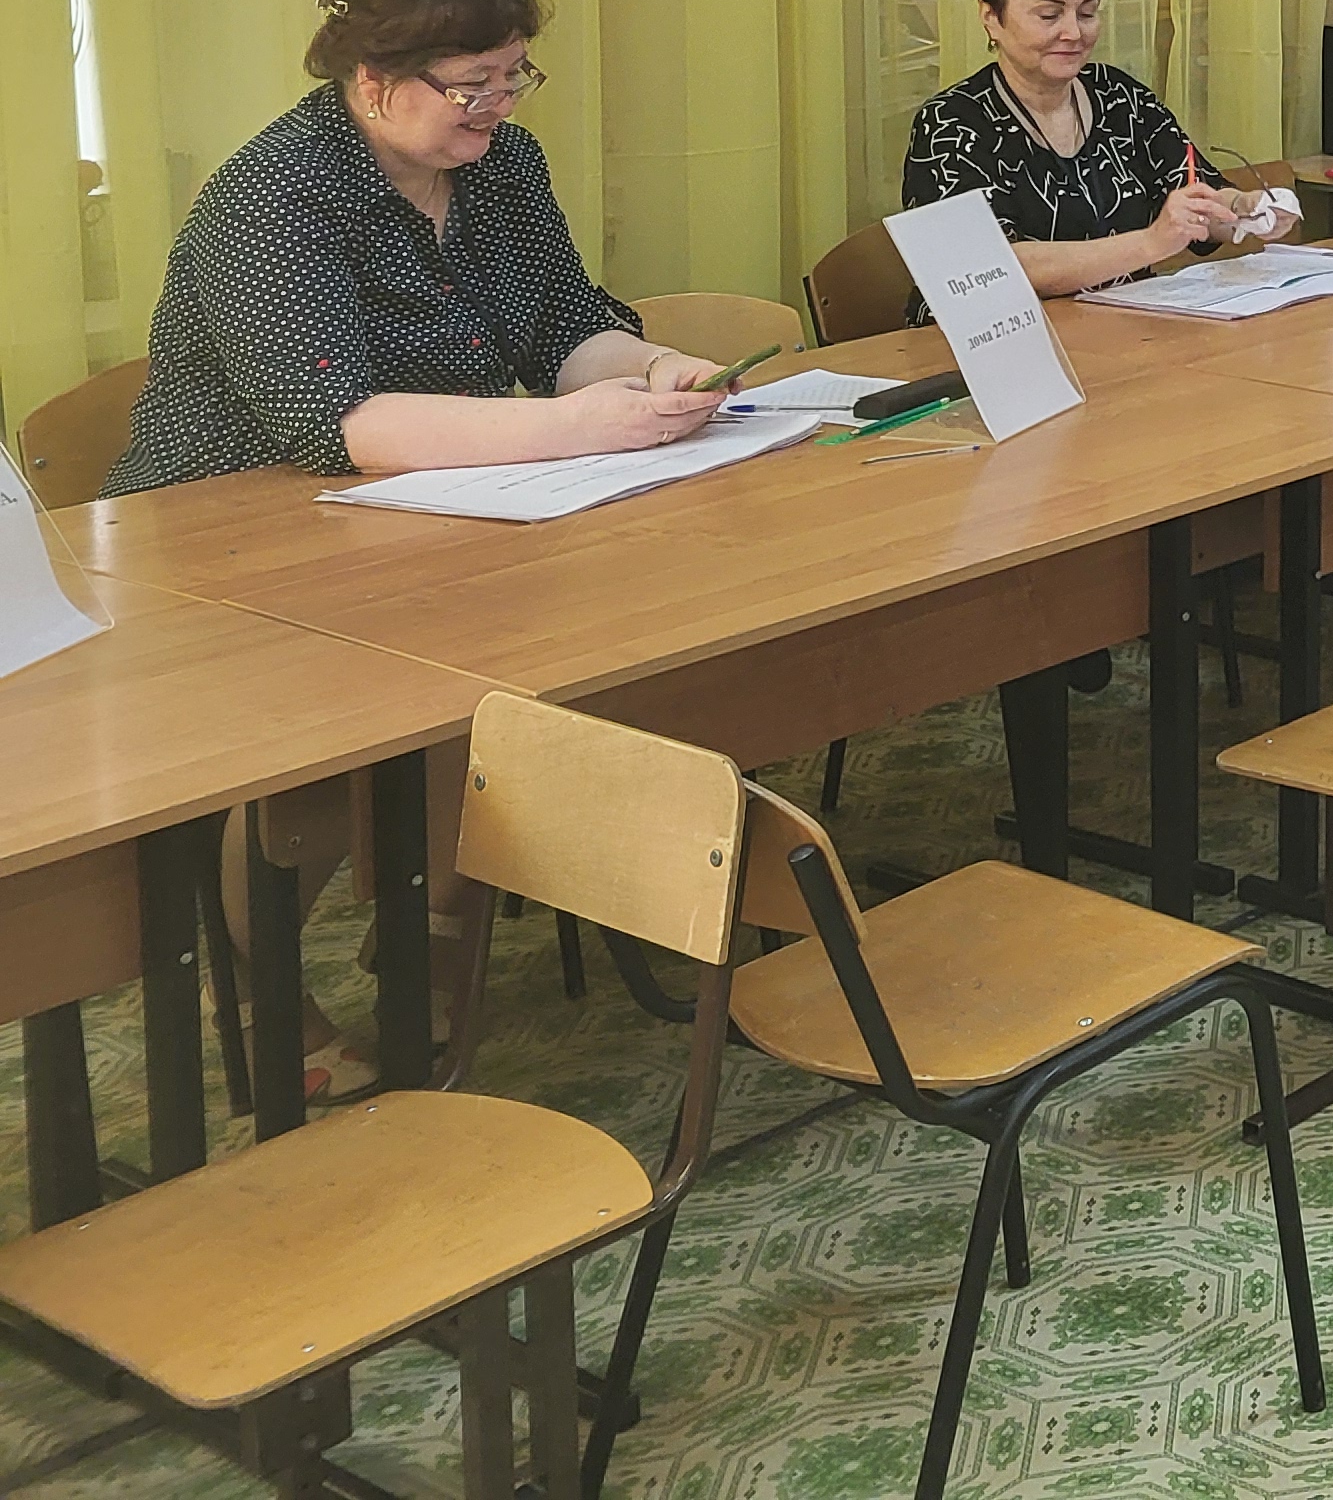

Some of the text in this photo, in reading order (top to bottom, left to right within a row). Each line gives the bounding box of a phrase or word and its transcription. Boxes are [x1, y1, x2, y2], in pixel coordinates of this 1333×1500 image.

[947, 266, 1009, 297] Пр.Героев,
[967, 308, 1037, 350] дома 27, 29, 31
